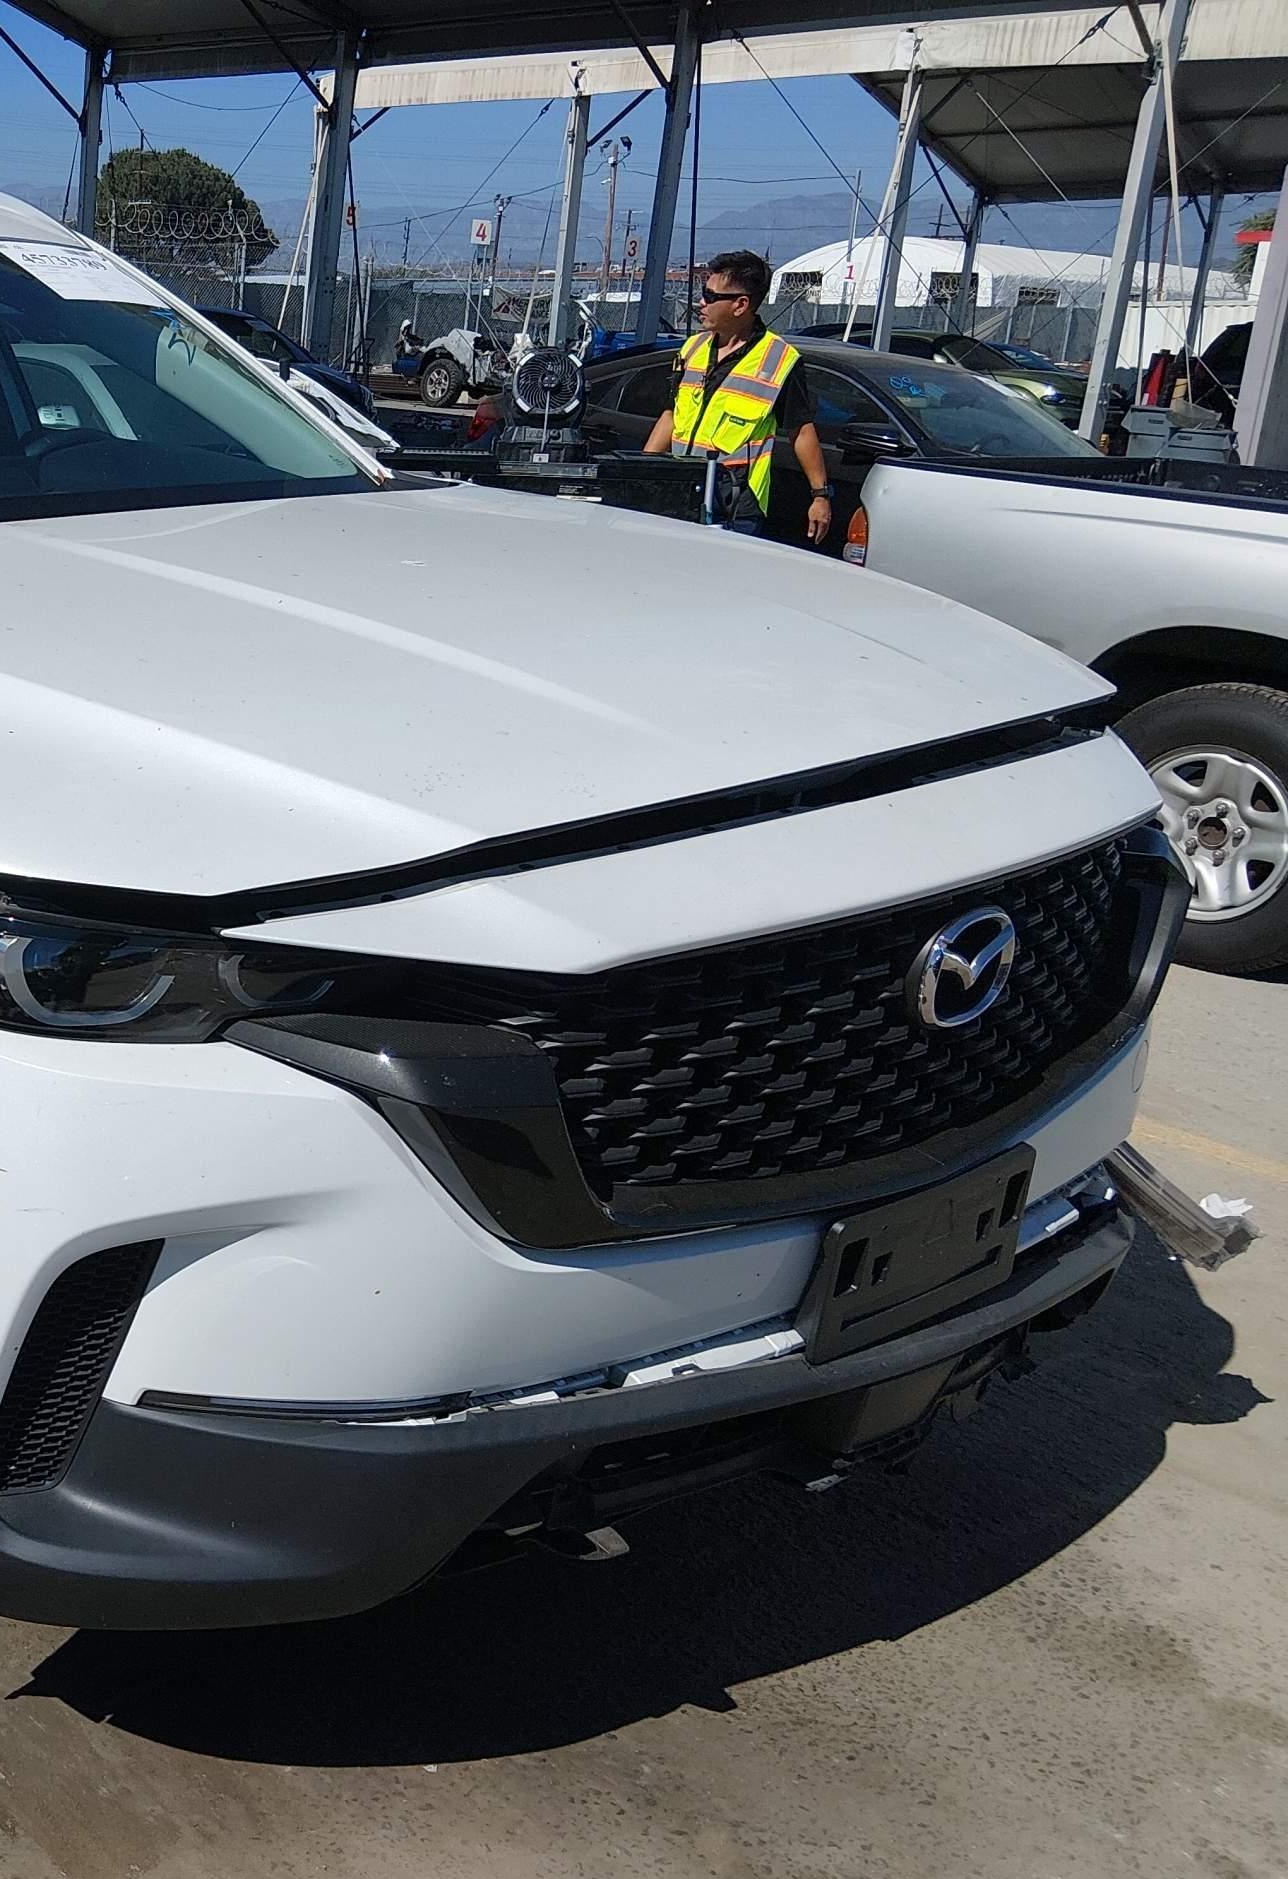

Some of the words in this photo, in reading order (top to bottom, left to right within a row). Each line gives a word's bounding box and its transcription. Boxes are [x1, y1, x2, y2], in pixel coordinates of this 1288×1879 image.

[475, 223, 487, 241] 4
[627, 240, 638, 257] 3
[844, 264, 854, 280] 1
